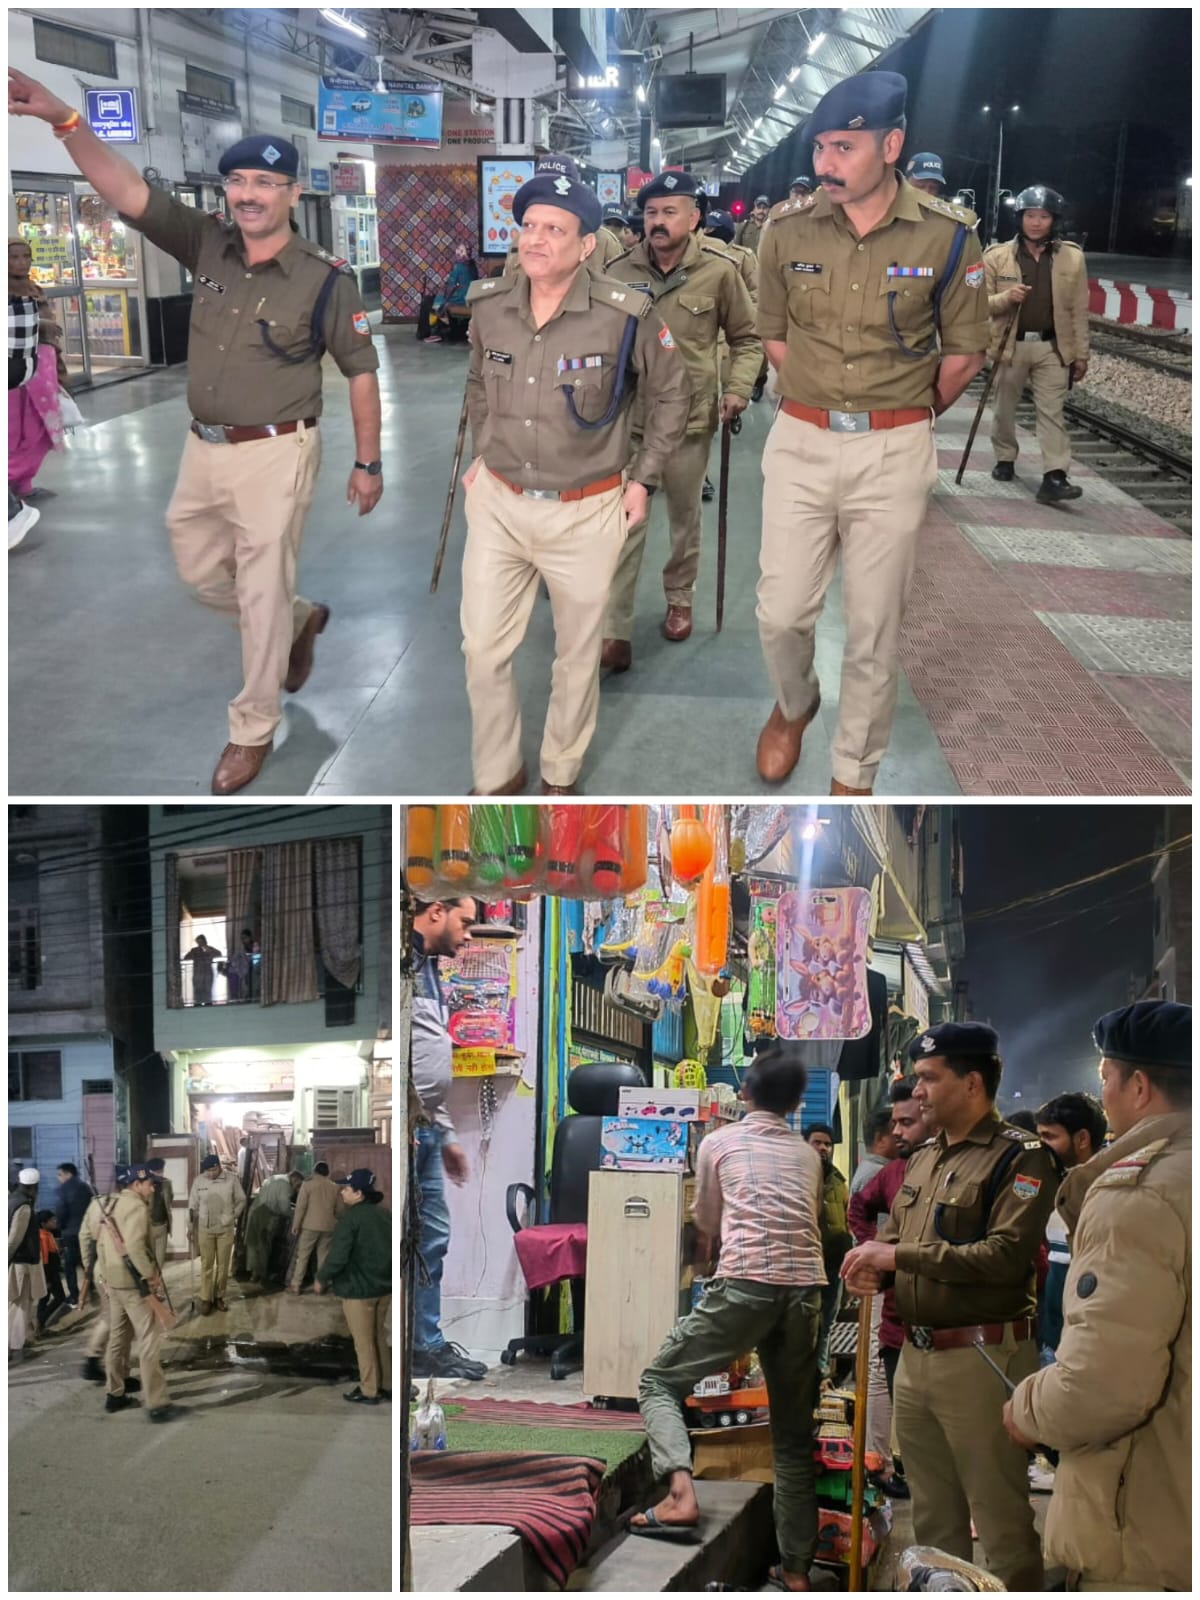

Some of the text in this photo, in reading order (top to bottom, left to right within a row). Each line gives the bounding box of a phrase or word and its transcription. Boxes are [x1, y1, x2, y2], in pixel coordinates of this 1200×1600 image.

[447, 129, 495, 137] ONE STATION
[447, 137, 461, 145] ONE
[538, 160, 567, 173] POLICE
[923, 161, 941, 169] POLICE
